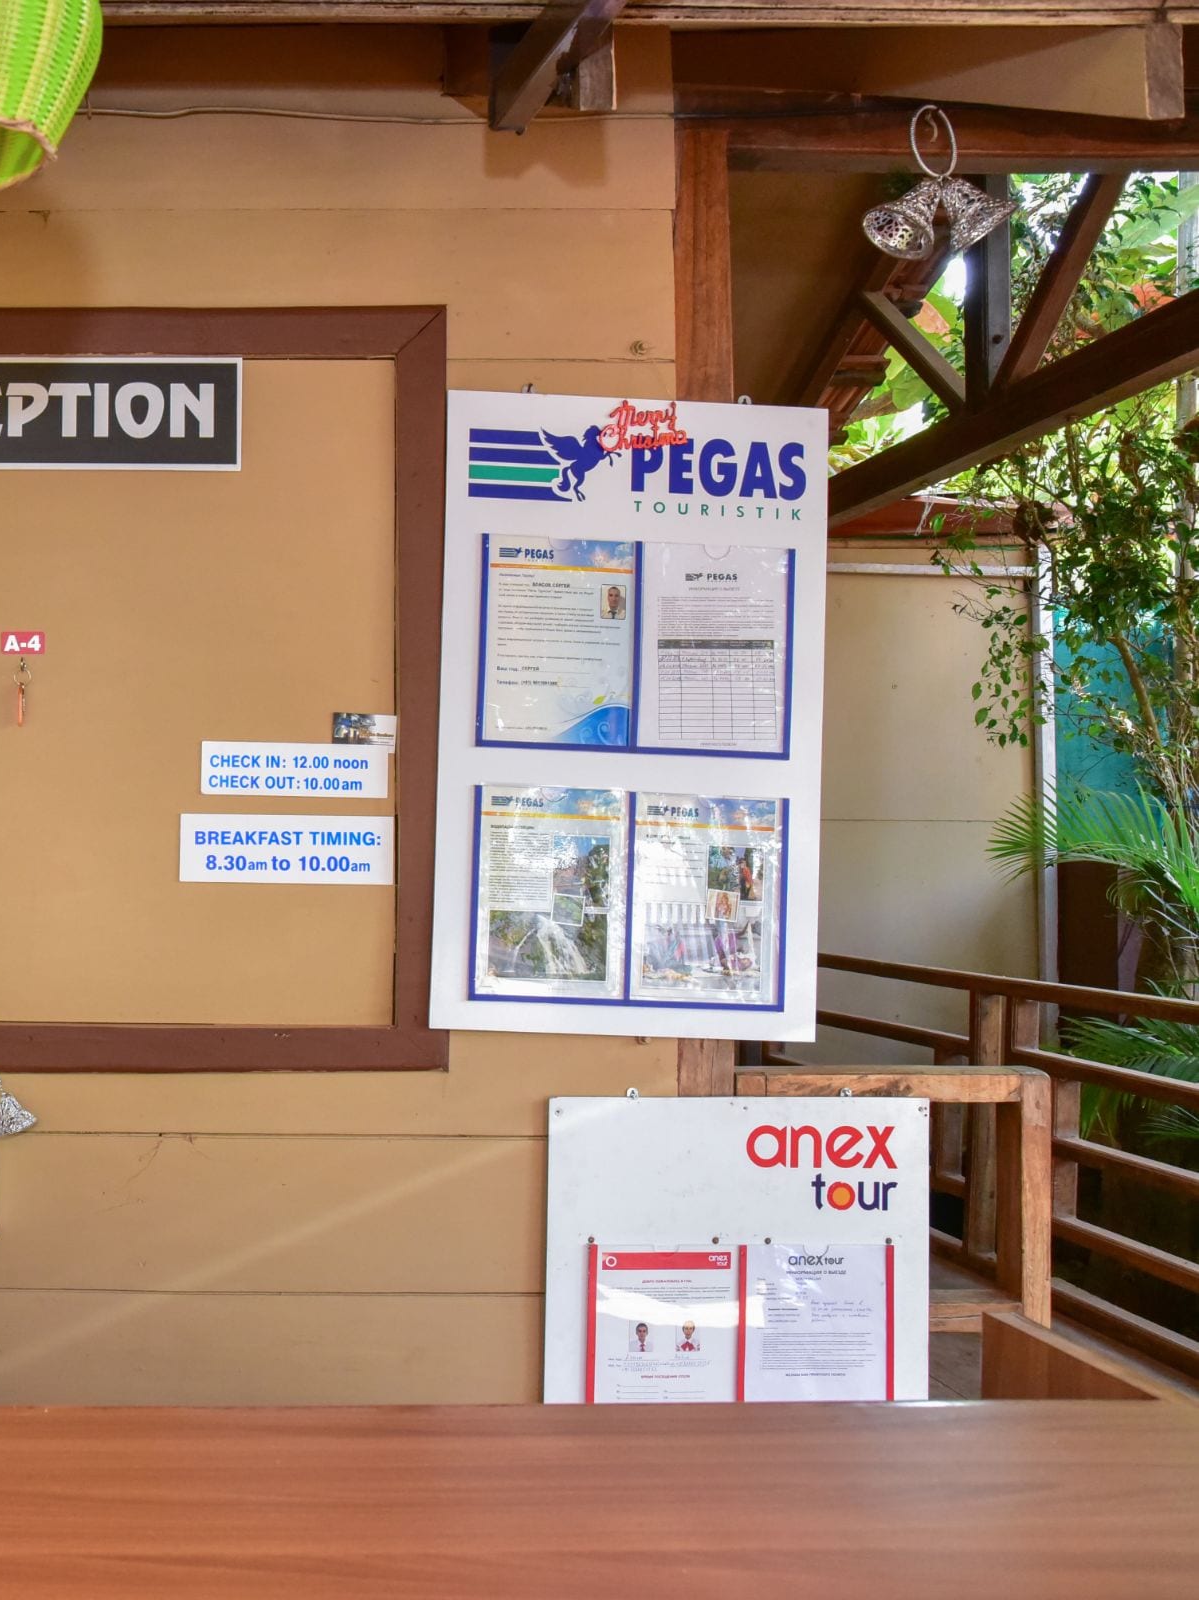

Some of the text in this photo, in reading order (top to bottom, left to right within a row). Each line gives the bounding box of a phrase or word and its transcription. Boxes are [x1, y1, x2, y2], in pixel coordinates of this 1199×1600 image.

[609, 400, 677, 430] Merry
[631, 438, 807, 501] PEGAS
[634, 501, 801, 521] TOURISTIK
[525, 548, 554, 559] PEGAS
[706, 573, 738, 581] PEGAS
[3, 635, 41, 651] A-4
[210, 754, 369, 769] CHECK IN: 12.00 noon
[208, 775, 260, 788] CHECK
[265, 776, 301, 790] OUT:
[670, 806, 699, 817] PEGAS
[194, 830, 381, 846] BREAKFAST TIMING:
[205, 855, 371, 872] 8.30am to 10.00am
[745, 1125, 898, 1169] anex
[811, 1173, 899, 1211] tour
